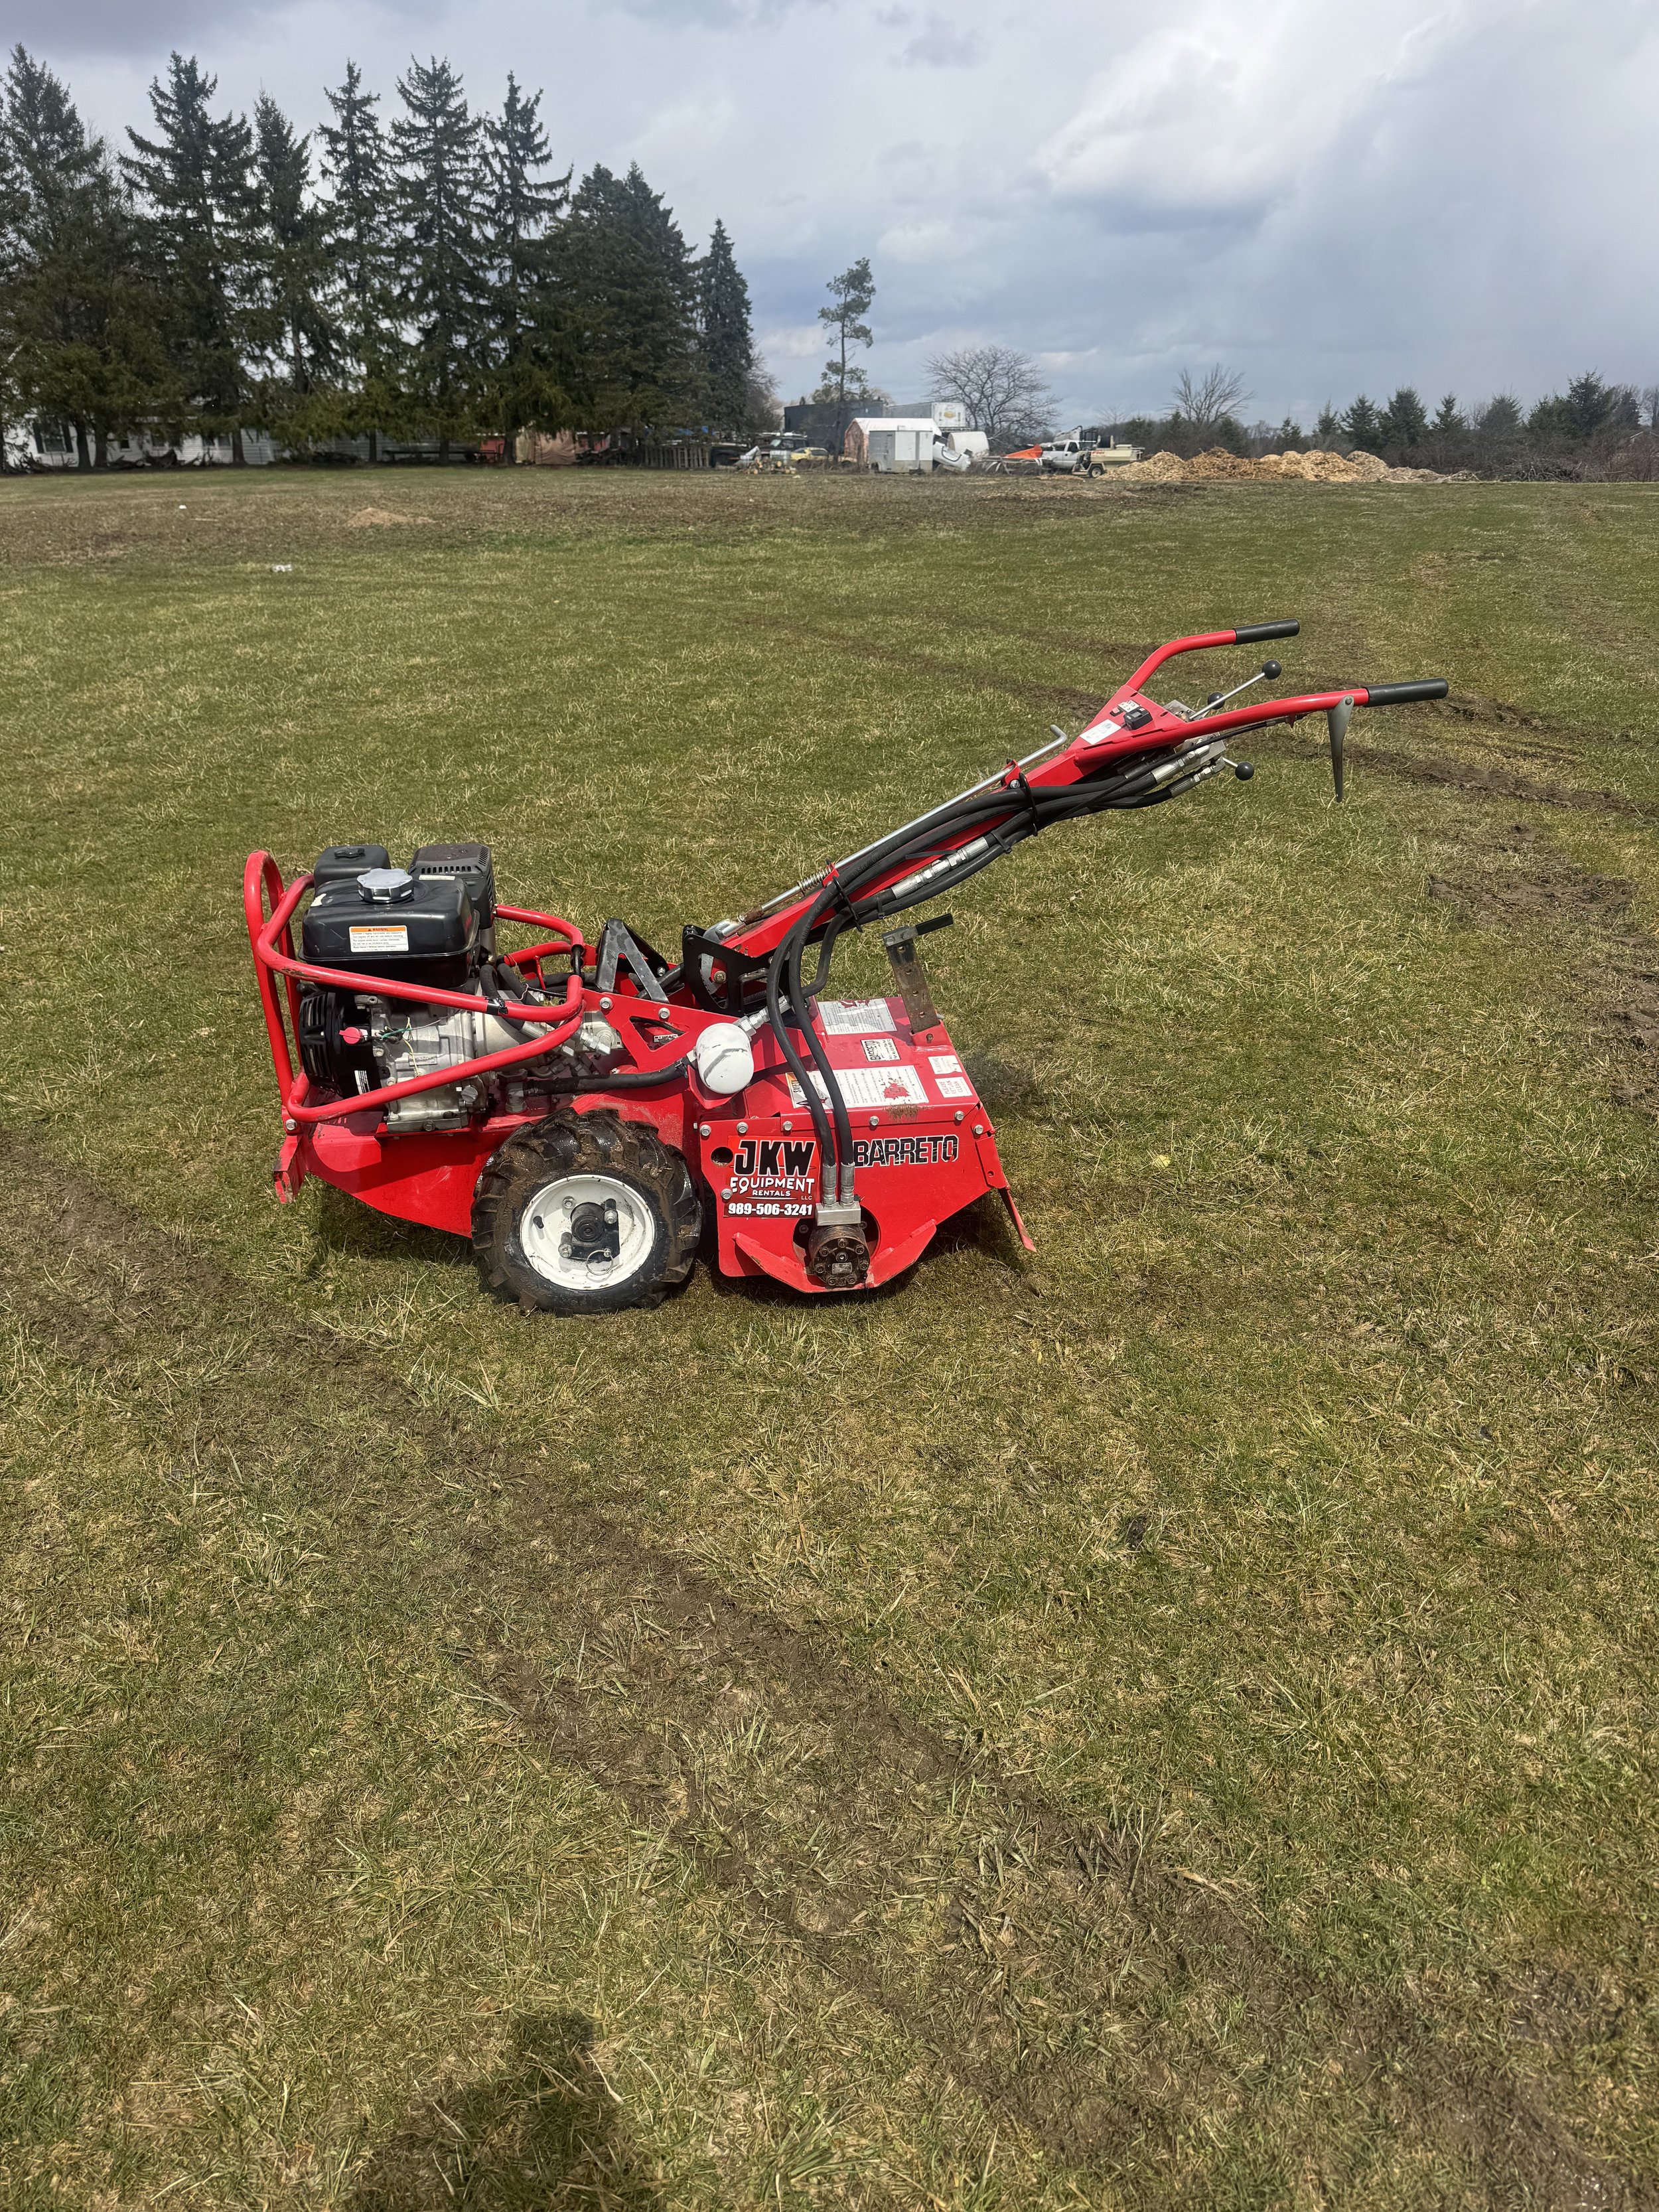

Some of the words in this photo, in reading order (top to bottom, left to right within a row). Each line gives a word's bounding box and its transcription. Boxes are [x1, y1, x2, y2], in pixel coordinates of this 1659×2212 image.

[733, 1139, 816, 1177] JKW
[853, 1134, 959, 1167] BARRETO
[730, 1177, 815, 1194] EQUIPMENT
[728, 1203, 813, 1215] 989-506-3241
